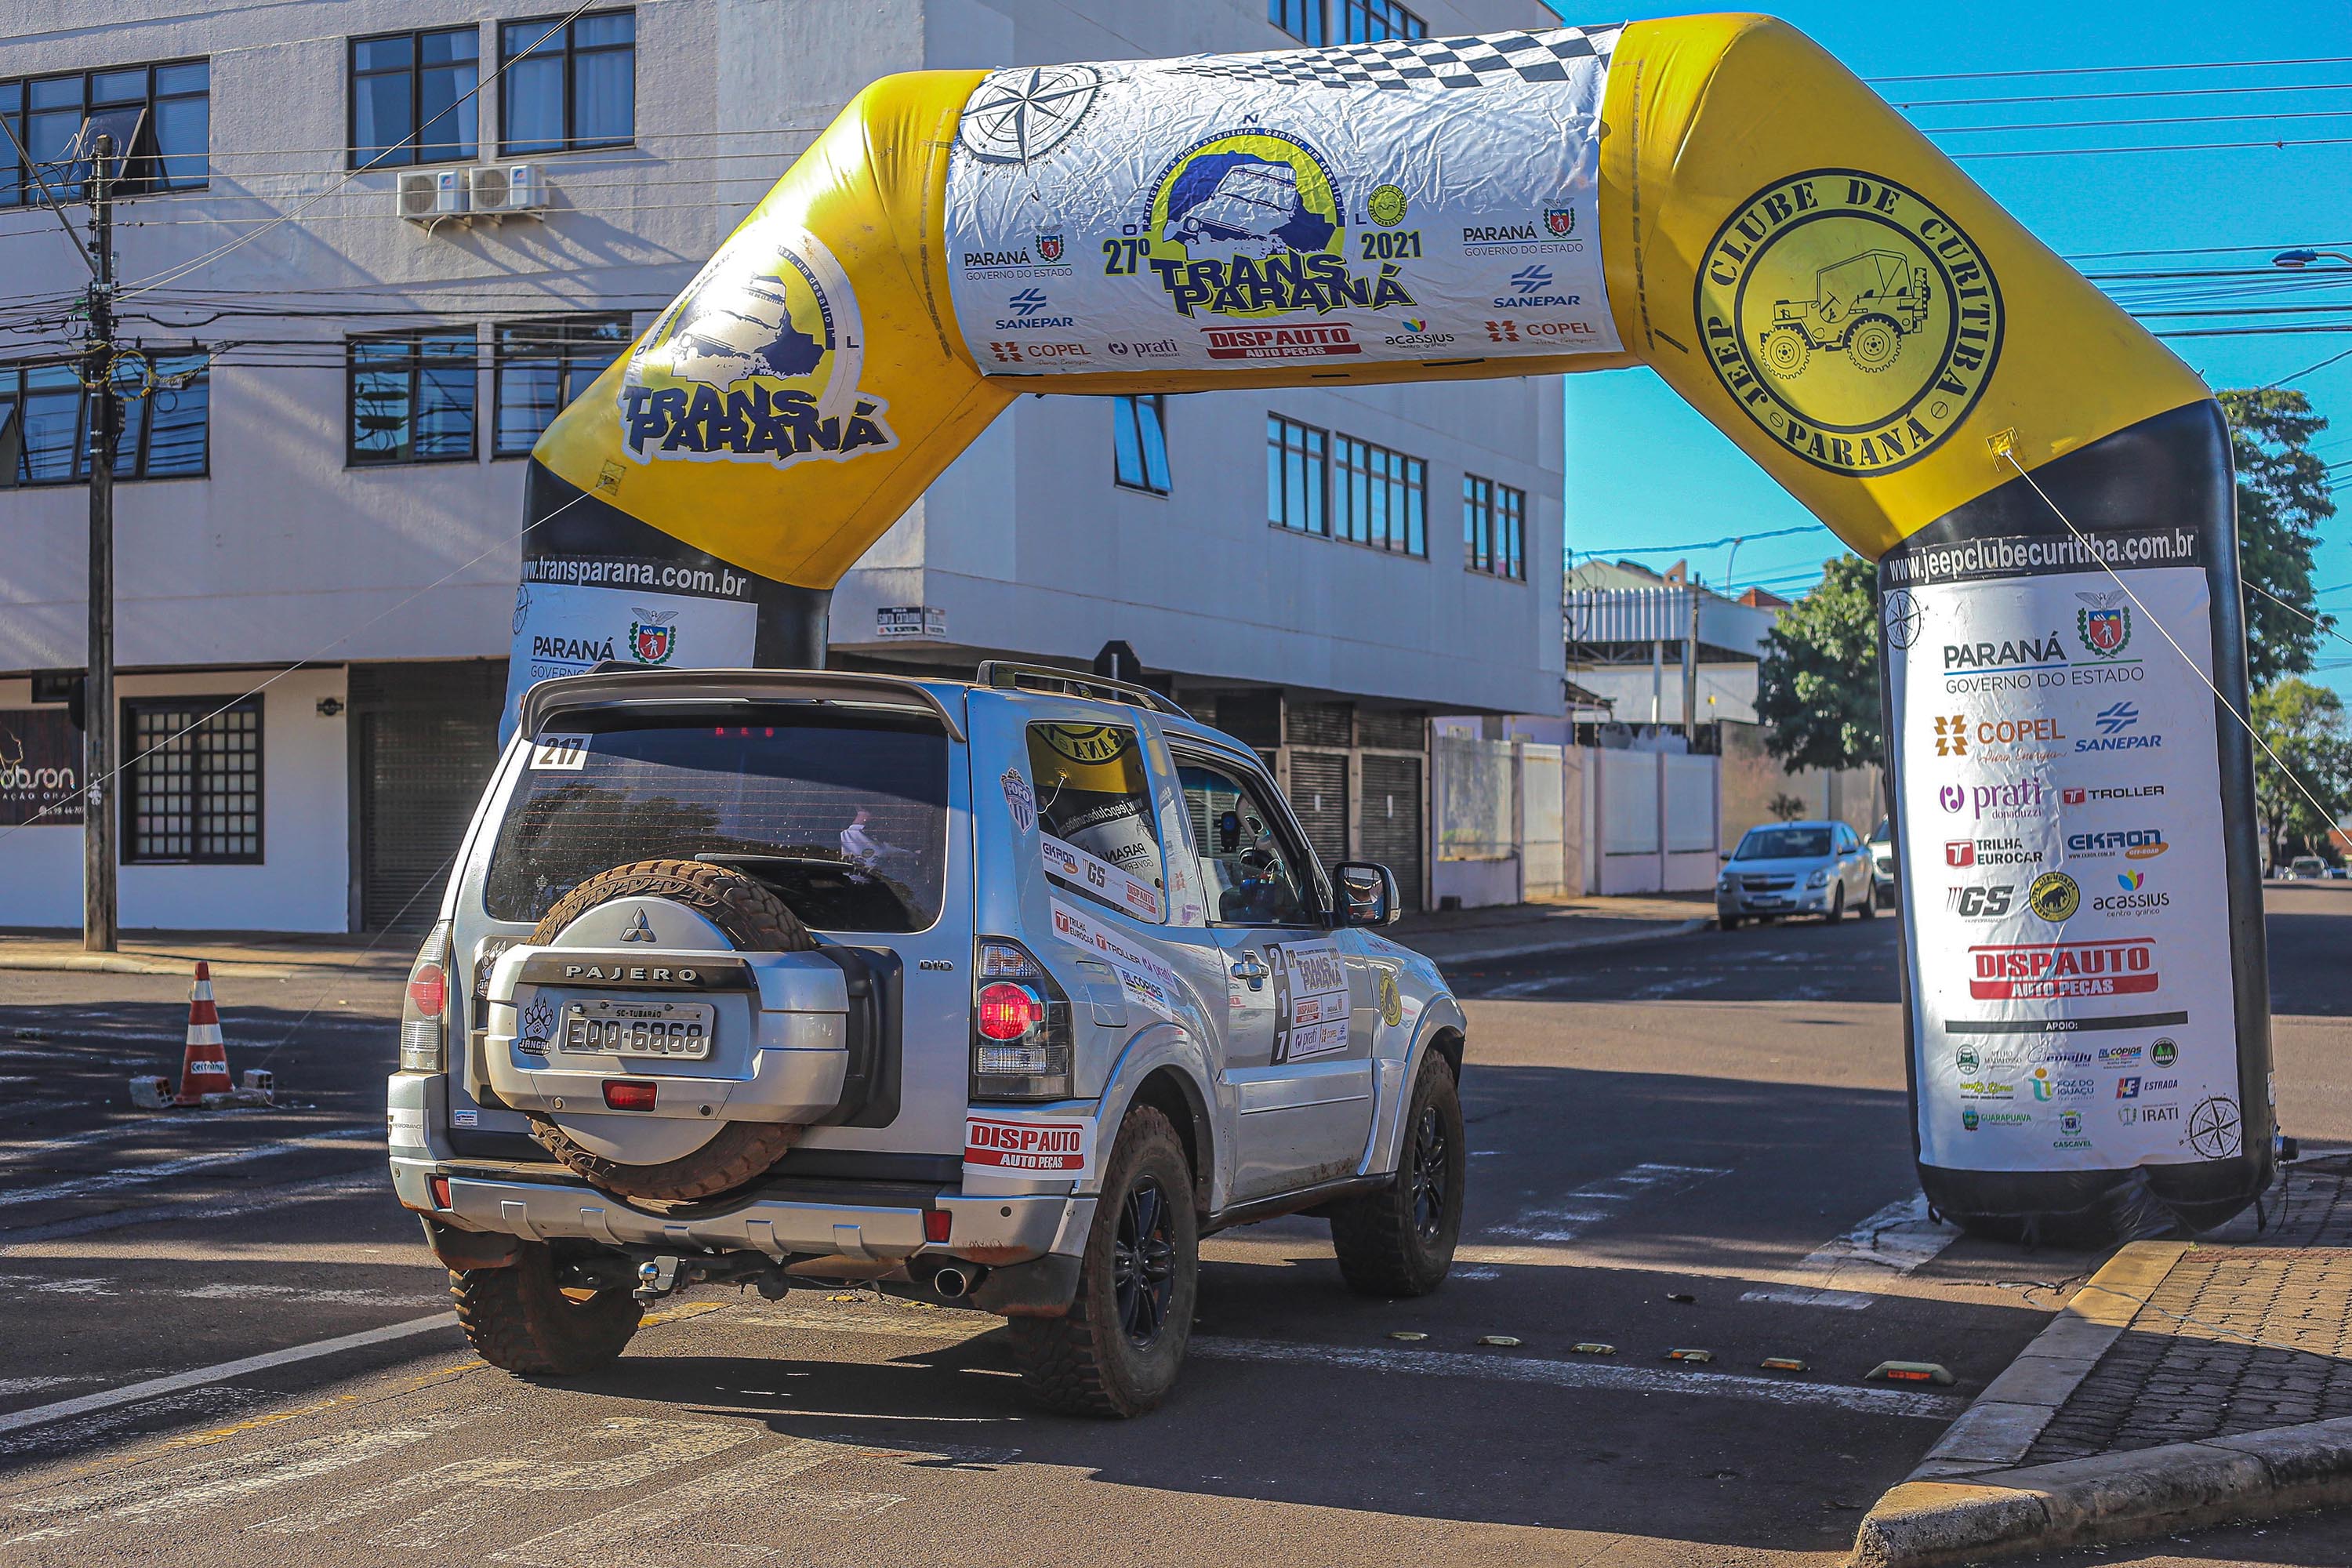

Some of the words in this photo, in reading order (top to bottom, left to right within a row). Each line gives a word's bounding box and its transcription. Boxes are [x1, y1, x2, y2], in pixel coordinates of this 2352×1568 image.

[1243, 114, 1259, 124] N
[1178, 143, 1200, 160] uma
[1307, 147, 1321, 162] um
[1462, 221, 1538, 242] PARANÁ
[1360, 230, 1421, 260] 2021
[1465, 245, 1519, 256] GOVERNO
[1520, 245, 1538, 255] DO
[1541, 242, 1584, 254] ESTADO
[964, 247, 1031, 267] PARANÁ
[966, 270, 1014, 281] GOVERNO
[1016, 269, 1032, 278] DO
[1034, 267, 1073, 278] ESTADO
[1149, 245, 1349, 297] TRANS
[797, 261, 810, 275] um
[809, 277, 832, 323] desafio
[1172, 262, 1417, 318] PARANÁ
[1709, 180, 1820, 287] CLUBE
[1845, 178, 1902, 216] DE
[1918, 217, 1991, 397] CURITIBA
[1493, 295, 1581, 308] SANEPAR
[995, 317, 1074, 330] SANEPAR
[1526, 321, 1596, 336] COPEL
[1208, 328, 1352, 347] DISPAUTO
[1385, 332, 1455, 347] acassius
[1028, 343, 1092, 358] COPEL
[1132, 339, 1178, 358] prati
[1246, 347, 1280, 358] AUTO
[1283, 346, 1327, 358] PEÇAS
[1708, 315, 1769, 408] JEEP
[1784, 408, 1935, 467] PARANÁ
[623, 383, 819, 424] TRANS
[627, 401, 890, 461] PARANÁ
[1889, 527, 2194, 584] www.jeepclubecuritiba.com.br
[532, 637, 615, 662] PARANÁ
[1944, 631, 2067, 670] PARANÁ
[1945, 672, 2032, 694] GOVERNO
[2037, 671, 2067, 688] DO
[2072, 666, 2145, 685] ESTADO
[1976, 717, 2067, 745] COPEL
[539, 737, 584, 765] 217
[2074, 734, 2162, 753] SANEPAR
[1973, 777, 2042, 820] prati
[2088, 785, 2165, 800] TROLLER
[1991, 808, 2042, 820] donaduzzi
[1976, 837, 2024, 851] TRILHA
[2067, 829, 2162, 851] EKRON
[1977, 851, 2044, 866] EUROCAR
[1958, 884, 2016, 917] GS
[2092, 892, 2170, 910] acassius
[2135, 908, 2160, 917] gráfico
[1069, 916, 1087, 932] TRILHA
[1069, 928, 1095, 946] EUROCAR
[1106, 941, 1142, 967] TROLLER
[1976, 946, 2151, 978] DISPAUTO
[564, 965, 699, 984] PAJERO
[2011, 982, 2055, 997] AUTO
[2059, 978, 2114, 997] PEÇAS
[2045, 1020, 2078, 1032] APOIO:
[2057, 1080, 2076, 1088] FOZ
[2078, 1079, 2095, 1087] DO
[2057, 1087, 2095, 1096] IGUAÇU
[2144, 1079, 2178, 1091] ESTRADA
[1980, 1112, 2032, 1122] GUARAPUAVA
[2142, 1107, 2179, 1123] IRATI
[971, 1124, 1080, 1152] DISPAUTO
[2053, 1140, 2092, 1149] CASCAVEL
[1000, 1152, 1036, 1168] AUTO
[1039, 1154, 1063, 1171] PEÇAS
